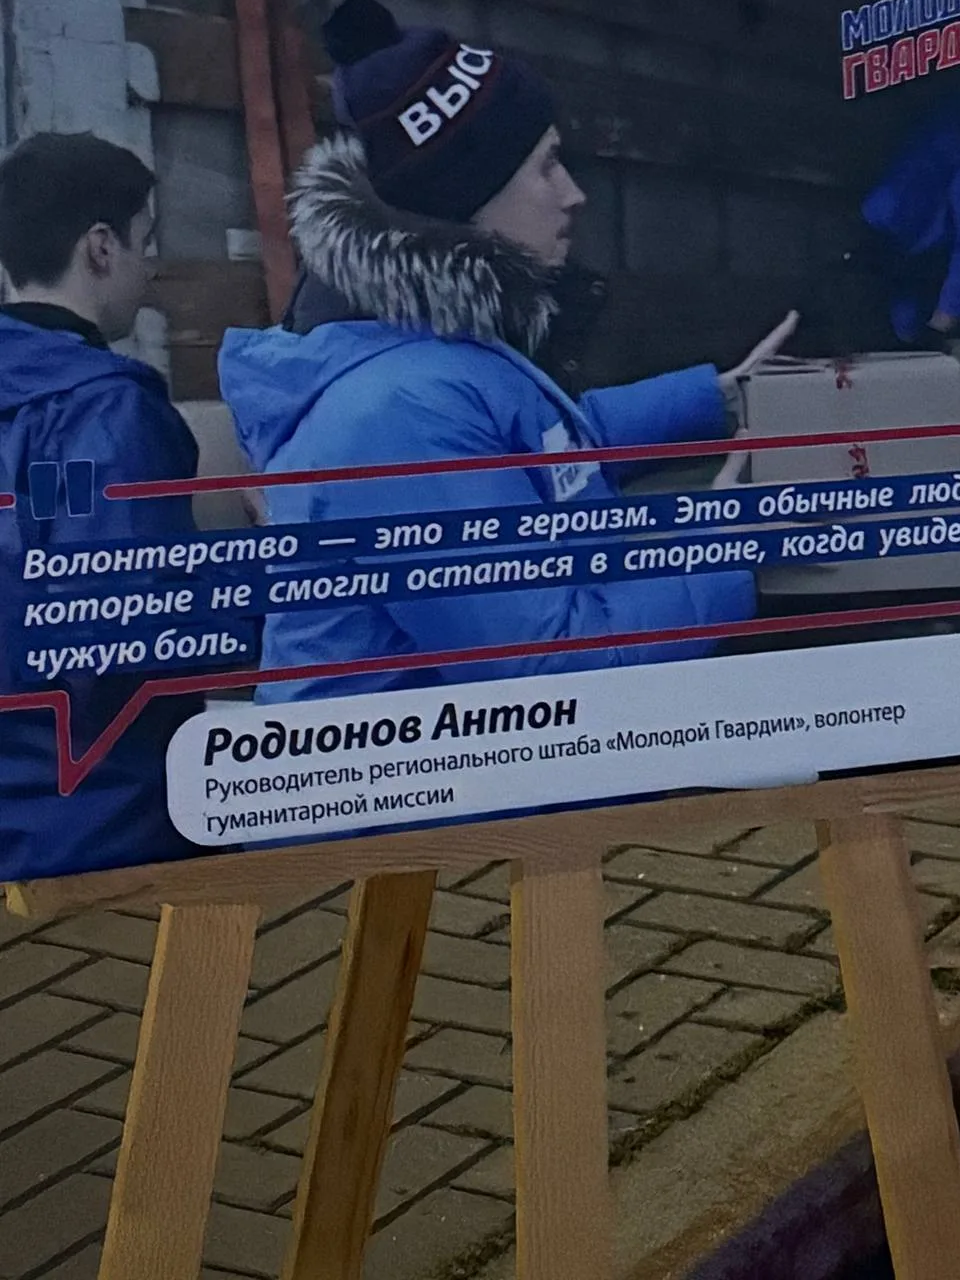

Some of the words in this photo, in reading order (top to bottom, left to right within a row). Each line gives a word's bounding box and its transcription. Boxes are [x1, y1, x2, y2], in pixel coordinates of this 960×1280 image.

[23, 534, 298, 580] Волонтерство
[374, 523, 443, 549] это
[462, 518, 500, 542] не
[517, 506, 656, 542] героизм.
[674, 496, 741, 524] Это
[759, 486, 894, 516] обычные
[24, 589, 193, 627] которые
[211, 584, 251, 609] не
[269, 572, 389, 603] смогли
[407, 555, 574, 591] остаться
[590, 552, 607, 574] в
[624, 539, 766, 573] стороне,
[781, 525, 865, 557] когда
[26, 639, 146, 680] чужую
[154, 628, 248, 661] боль.
[204, 715, 422, 766] Родионов
[431, 698, 578, 741] Антон
[205, 767, 363, 803] Руководитель
[369, 746, 533, 785] регионального
[538, 734, 600, 761] штаба
[606, 722, 710, 752] «Молодой
[715, 715, 809, 740] Гвардии»,
[815, 703, 906, 730] волонтер
[206, 794, 367, 836] гуманитарной
[373, 787, 454, 812] миссии
